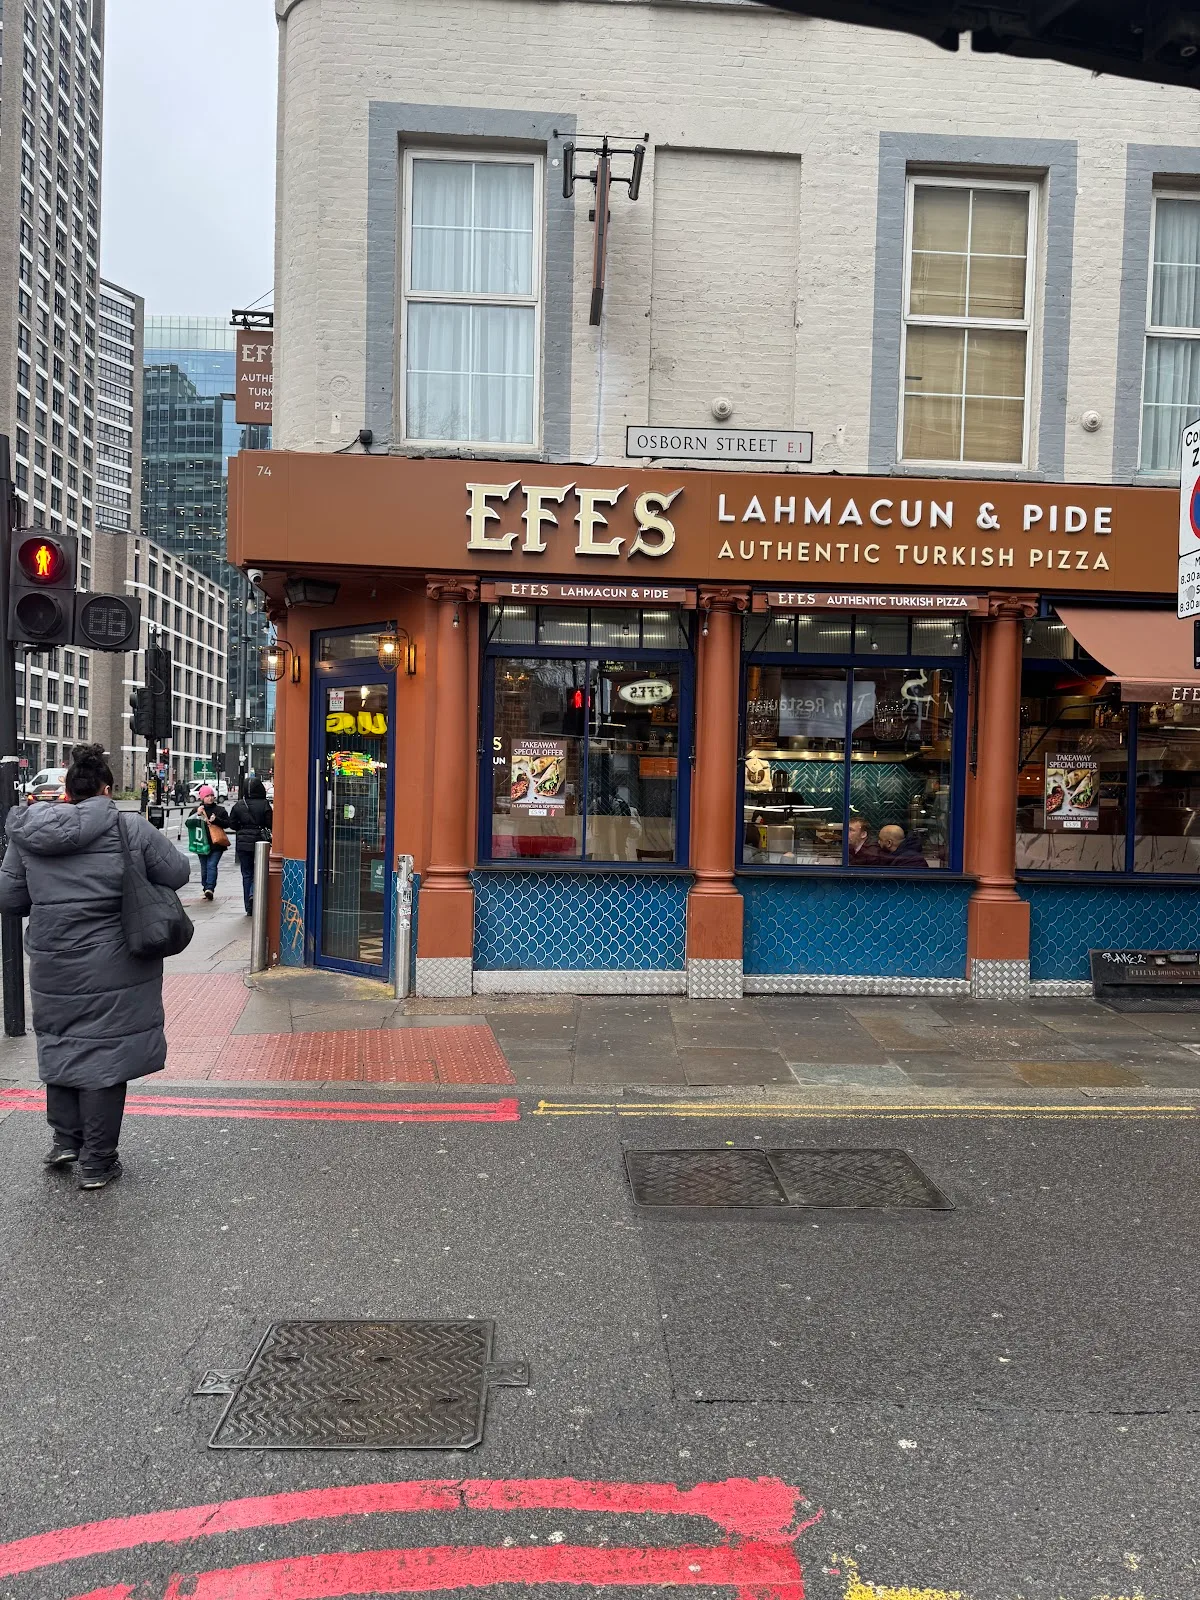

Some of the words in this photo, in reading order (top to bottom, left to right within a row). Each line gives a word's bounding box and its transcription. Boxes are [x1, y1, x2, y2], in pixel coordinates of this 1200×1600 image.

[637, 435, 707, 450] OSBORN
[716, 437, 778, 452] STREET
[256, 465, 272, 477] 74
[466, 479, 685, 559] EFES
[718, 493, 953, 530] LAHMACUN
[976, 502, 1000, 531] &
[1023, 504, 1113, 534] PIDE
[717, 539, 881, 564] AUTHENTIC
[895, 545, 1014, 568] TURKISH
[1029, 549, 1110, 571] PIZZA
[511, 583, 549, 596] EFES
[560, 587, 627, 598] LAHMACUN
[631, 588, 640, 598] &
[643, 589, 669, 599] PIDE
[778, 592, 816, 605] EFES
[826, 595, 886, 606] AUTHENTIC
[889, 597, 933, 607] TURKISH
[936, 598, 968, 607] PIZZA
[513, 748, 540, 756] SPECIAL
[521, 741, 557, 749] TAKEAWAY
[1056, 754, 1091, 762] TAKEAWAY
